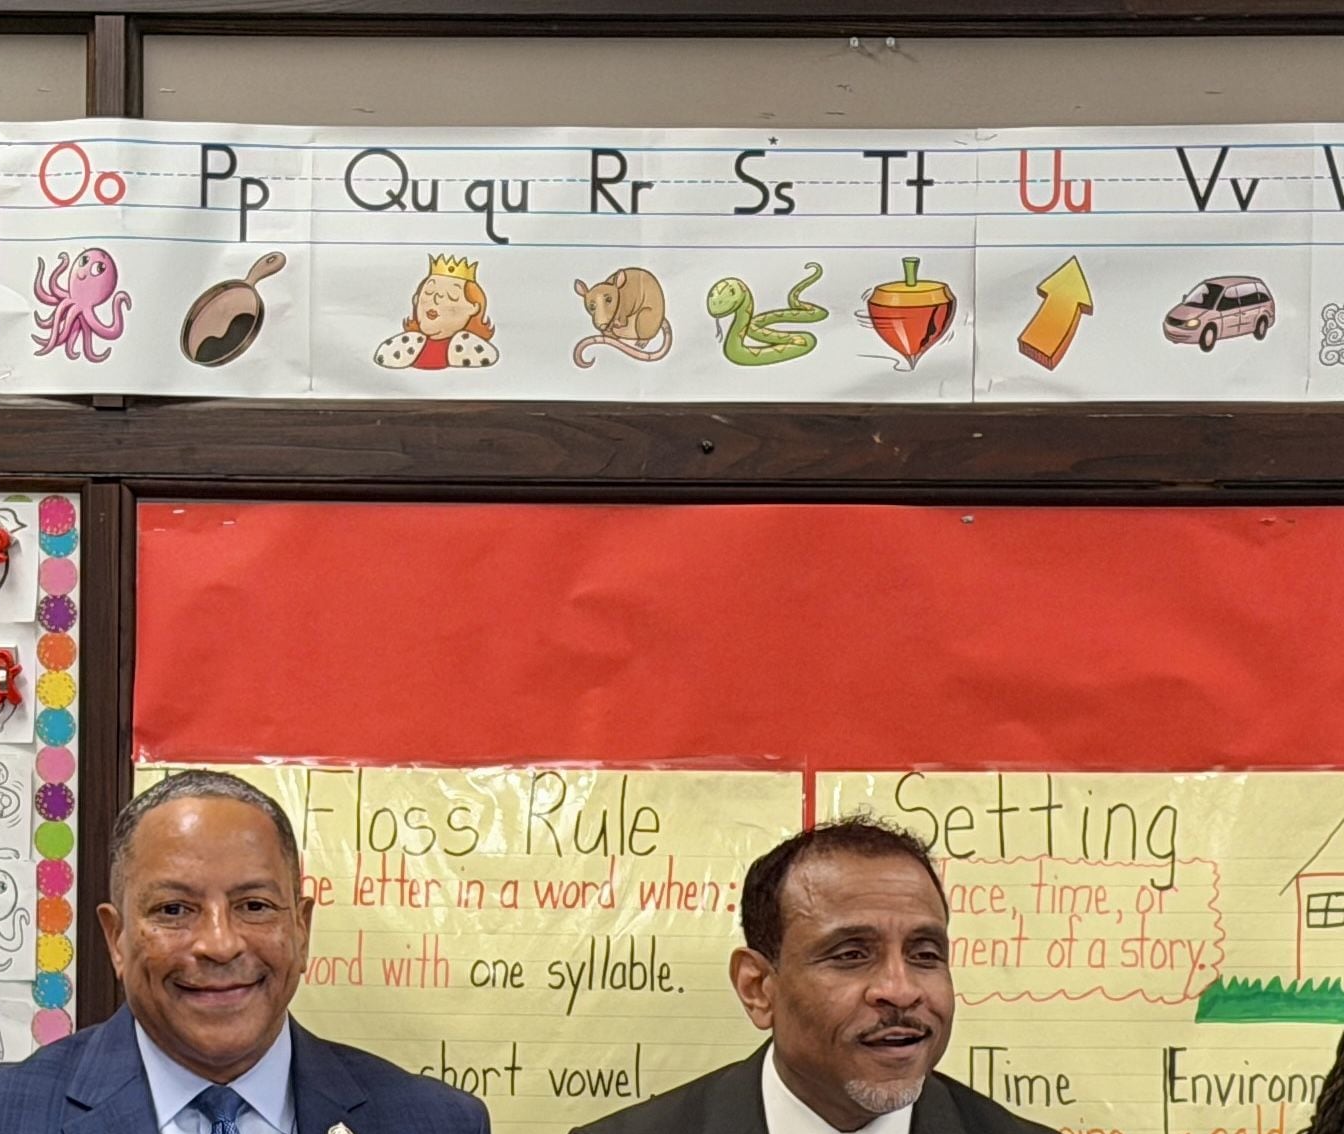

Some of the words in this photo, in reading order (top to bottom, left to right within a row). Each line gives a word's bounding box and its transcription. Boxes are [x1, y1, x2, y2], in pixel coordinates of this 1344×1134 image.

[40, 144, 125, 206] Oo
[201, 144, 268, 240] Pp
[591, 149, 651, 214] Rr
[735, 150, 794, 214] Ss
[864, 151, 933, 214] Tt
[1021, 153, 1091, 211] Uu
[1176, 146, 1258, 211] Vv
[302, 769, 479, 853] Floss
[526, 770, 661, 857] Rule
[895, 772, 1176, 889] Setting
[353, 851, 442, 908] letter
[457, 867, 485, 909] in
[501, 880, 519, 909] a
[534, 856, 616, 910] word
[383, 933, 449, 988] with
[471, 958, 524, 988] one
[548, 936, 685, 1015] syllable.
[1088, 938, 1106, 969] a
[970, 1046, 1077, 1105] Time
[1169, 1046, 1326, 1106] Environ
